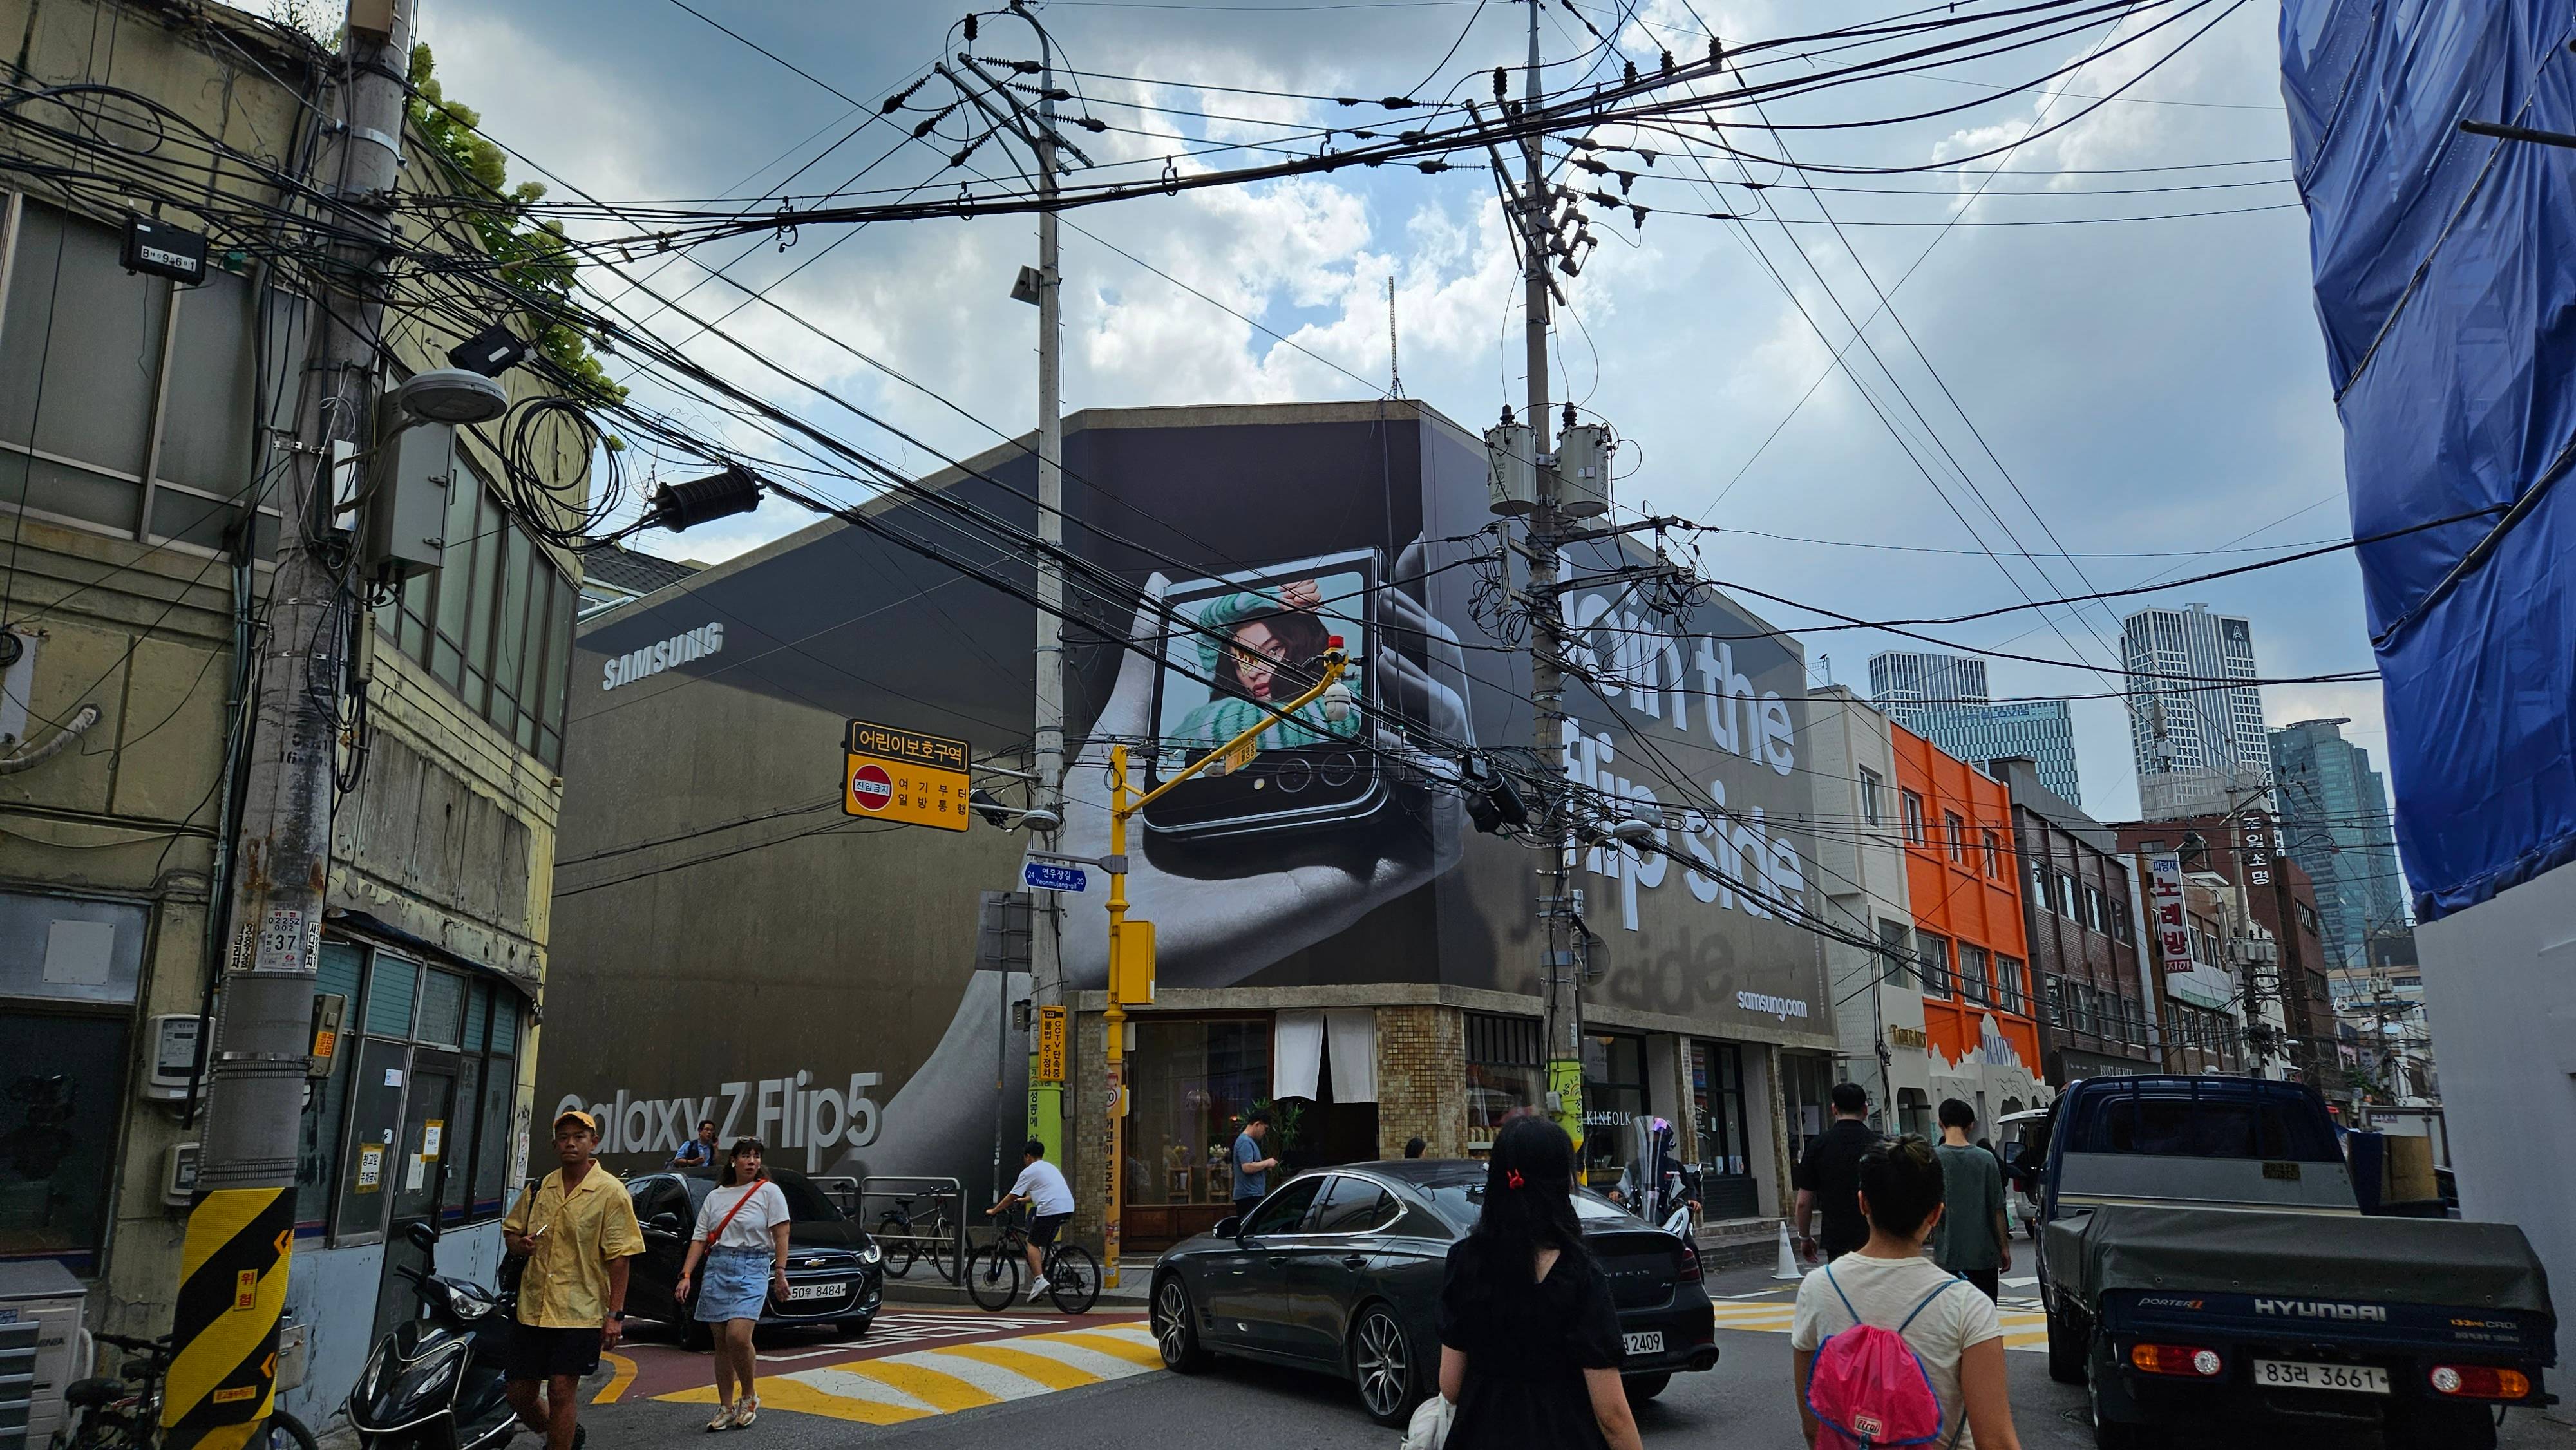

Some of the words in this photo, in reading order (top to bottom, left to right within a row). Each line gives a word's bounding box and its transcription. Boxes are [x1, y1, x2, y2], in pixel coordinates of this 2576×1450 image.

[602, 621, 724, 691] SAMSUNG
[1695, 631, 1794, 776] the
[860, 730, 961, 766] 어린이보호구역
[856, 780, 889, 795] 진입금지
[898, 778, 967, 801] 여기부터
[898, 793, 966, 816] 일방통행
[1682, 780, 1804, 926] side
[1027, 871, 1035, 879] 24
[1036, 878, 1077, 890] Yeonmujang-gil
[1042, 867, 1072, 881] 연무장길
[1077, 877, 1084, 885] 20
[2157, 877, 2187, 955] 노래방
[274, 934, 296, 951] 37
[1737, 990, 1808, 1022] samsung.com
[1044, 1021, 1052, 1040] 불법
[1052, 1050, 1061, 1078] 단속중
[719, 1081, 752, 1151] Z
[756, 1069, 883, 1174] Flip5
[1586, 1111, 1631, 1125] KINFOLK
[239, 1272, 255, 1306] 위험
[816, 1285, 840, 1297] 8484
[2255, 1299, 2387, 1322] HYUNDAI
[1631, 1333, 1660, 1352] 2409
[2320, 1366, 2374, 1389] 3661
